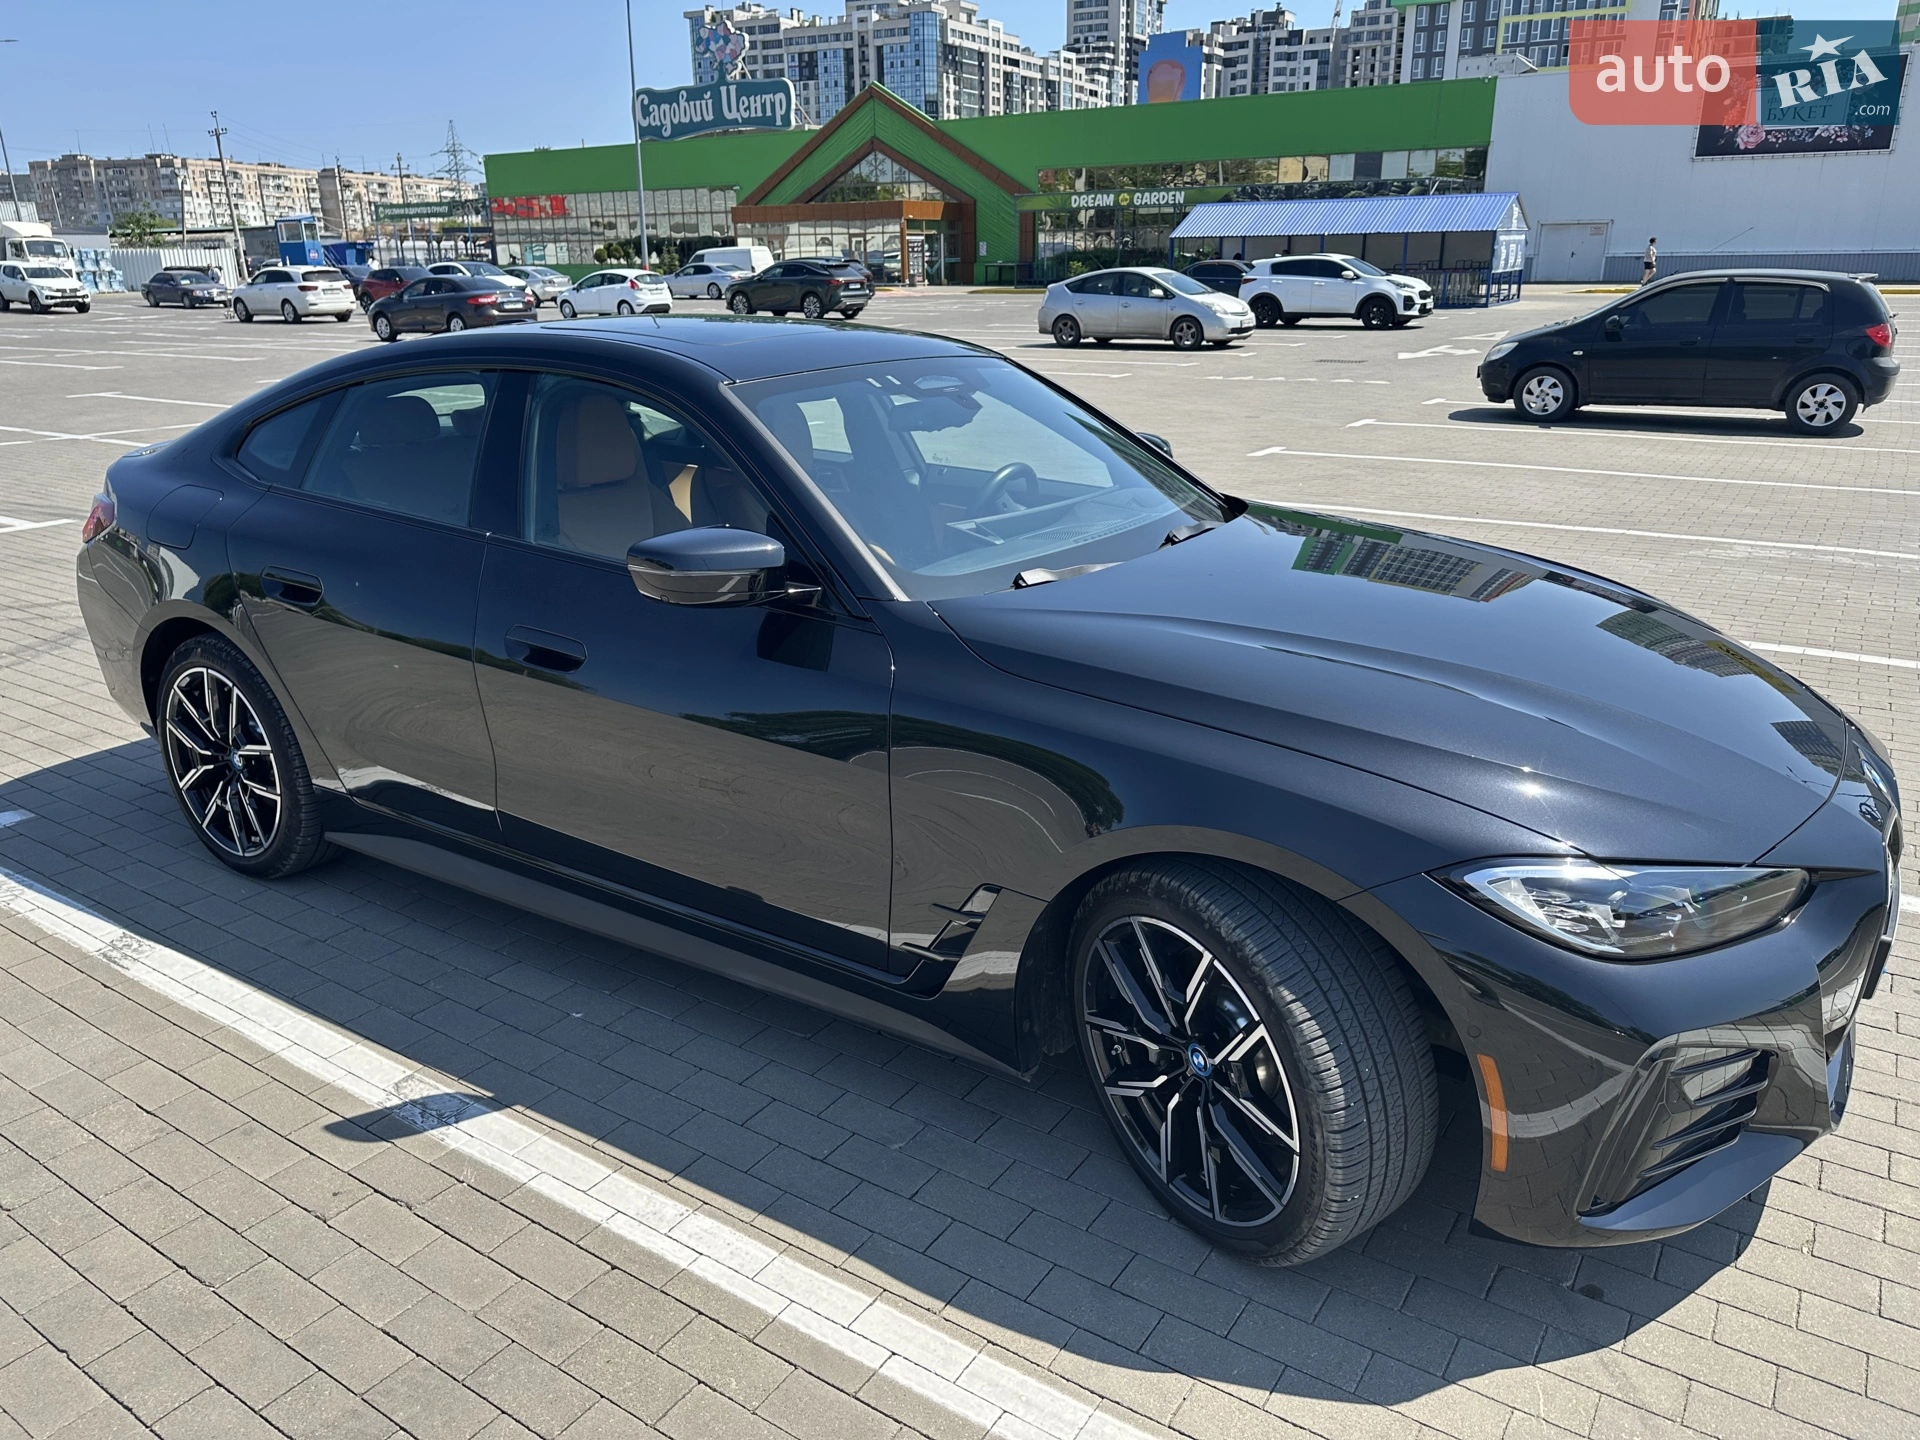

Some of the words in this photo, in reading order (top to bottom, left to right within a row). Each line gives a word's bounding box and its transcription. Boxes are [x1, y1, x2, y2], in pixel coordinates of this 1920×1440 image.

[636, 89, 714, 137] Садовий
[719, 84, 787, 126] Центр
[1766, 104, 1833, 122] БУКЕТ
[1071, 193, 1115, 208] DREAM
[1133, 191, 1185, 206] GARDEN
[1305, 1112, 1319, 1183] 245/40
